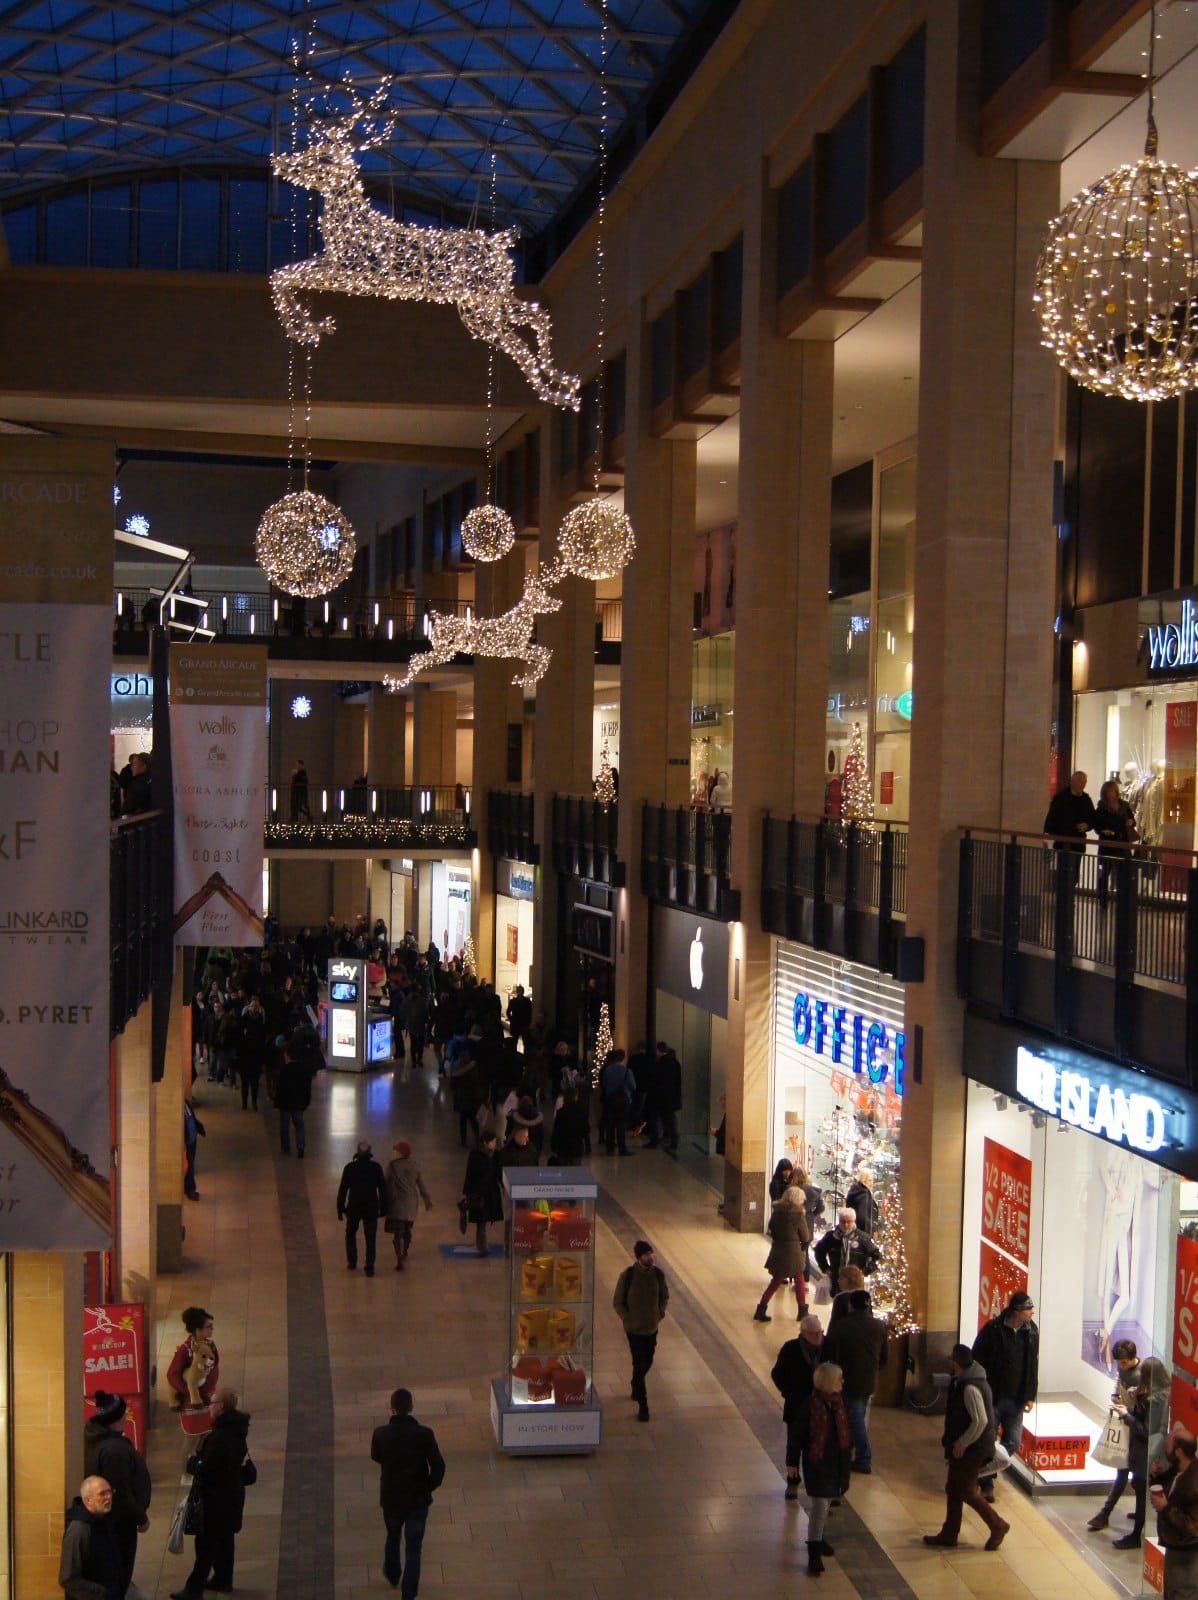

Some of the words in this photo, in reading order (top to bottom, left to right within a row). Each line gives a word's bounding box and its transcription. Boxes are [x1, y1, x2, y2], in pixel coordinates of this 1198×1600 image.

[192, 847, 240, 863] coast
[331, 961, 358, 980] sky
[18, 1005, 94, 1025] PYRET
[792, 991, 906, 1096] OFFICE
[984, 1161, 999, 1189] 1/2
[1000, 1172, 1030, 1208] PRICE
[983, 1190, 1028, 1254] SALE
[85, 1353, 134, 1373] SALE!
[561, 1424, 584, 1432] NOW
